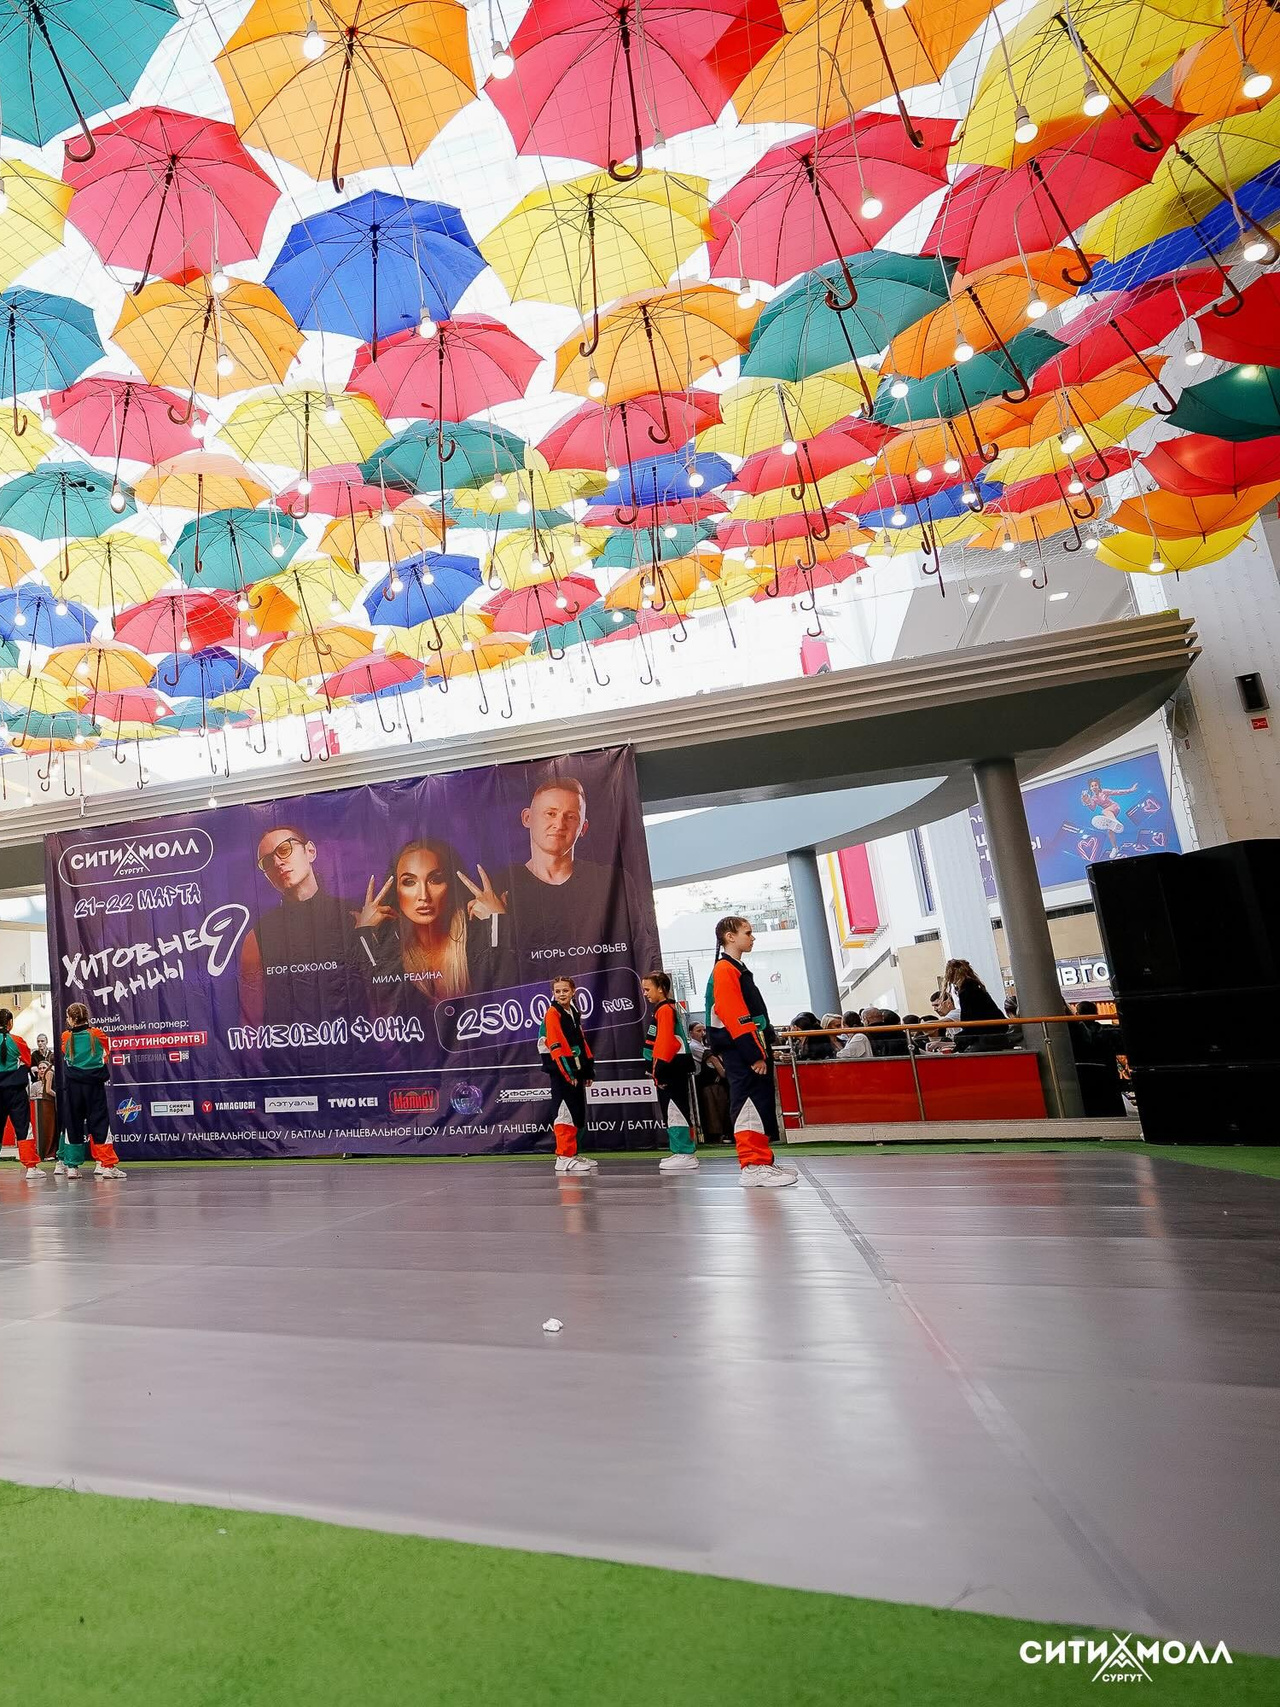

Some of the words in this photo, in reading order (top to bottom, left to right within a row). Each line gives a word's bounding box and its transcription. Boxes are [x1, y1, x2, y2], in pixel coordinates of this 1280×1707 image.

[71, 848, 122, 870] СИТИ
[139, 838, 200, 860] МОЛЛ
[119, 866, 145, 876] СУРГУТ
[74, 893, 134, 918] 21-22
[137, 883, 202, 910] МАРТА
[531, 948, 566, 960] ИГОРЬ
[568, 943, 628, 956] СОЛОВЬЕВ
[266, 965, 288, 975] ЕГОР
[290, 961, 338, 973] СОКОЛОВ
[372, 974, 402, 985] МИЛА
[404, 971, 443, 983] РЕДИНА
[89, 1014, 120, 1025] альный
[456, 986, 594, 1040] 250.00
[602, 998, 635, 1014] RUB
[97, 1021, 147, 1033] ационный
[148, 1020, 189, 1031] партнер:
[228, 1017, 348, 1050] ПРИЗОВОЙ
[350, 1015, 425, 1044] ФОНД
[590, 1085, 652, 1098] ванлав
[214, 1101, 256, 1111] YAMAGUCHI
[328, 1098, 355, 1108] TWO
[358, 1097, 379, 1107] KEI
[120, 1133, 142, 1143] ШОУ
[149, 1132, 180, 1142] БАТТЛЫ
[188, 1131, 257, 1141] ТАНЦЕВАЛЬНОЕ
[258, 1130, 283, 1140] ШОУ
[291, 1129, 326, 1139] БАТТЛЫ
[334, 1127, 411, 1138] ТАНЦЕВАЛЬНОЕ
[413, 1126, 439, 1136] ШОУ
[449, 1125, 488, 1135] БАТТЛЫ
[497, 1123, 554, 1134] ТАНЦЕВАЛ
[586, 1120, 617, 1131] ШОУ
